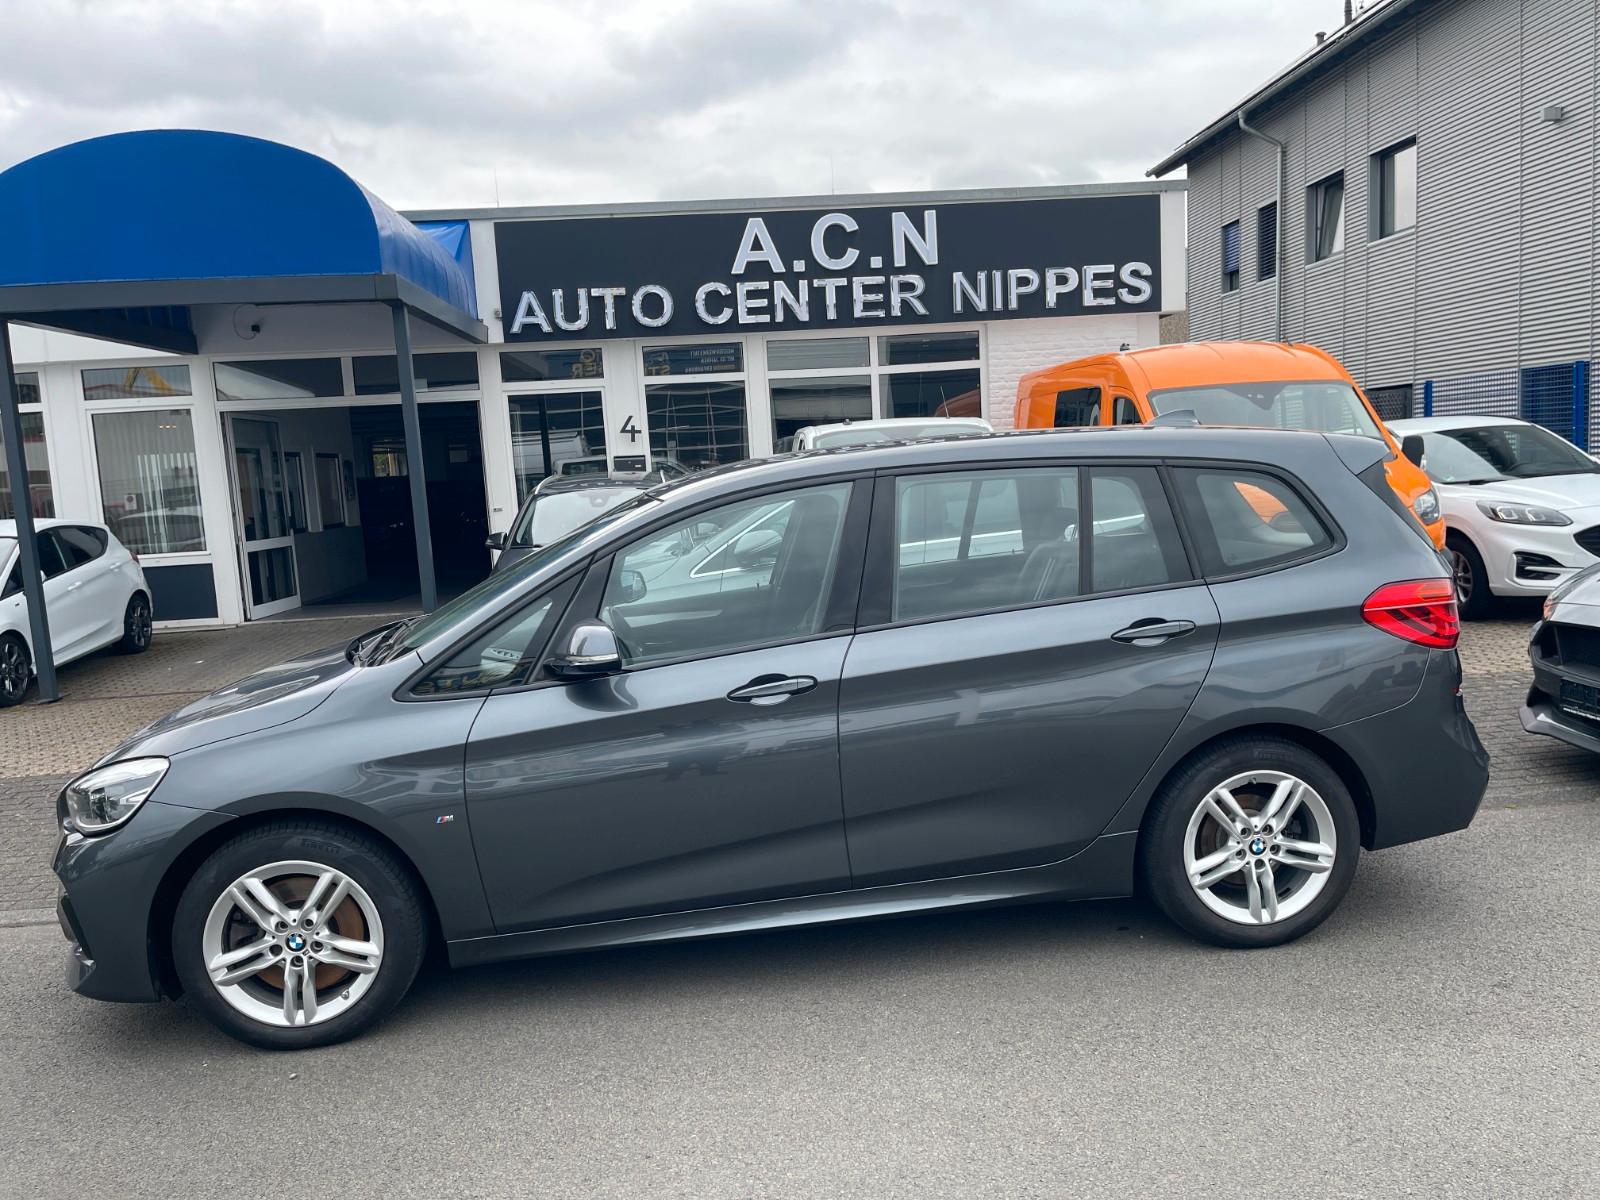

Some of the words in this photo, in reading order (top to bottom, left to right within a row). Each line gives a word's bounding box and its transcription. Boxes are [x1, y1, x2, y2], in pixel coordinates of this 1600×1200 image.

[732, 210, 939, 274] A.C.N
[511, 286, 675, 334] AUTO
[695, 274, 929, 325] CENTER
[953, 262, 1153, 314] NIPPES
[620, 415, 642, 442] 4
